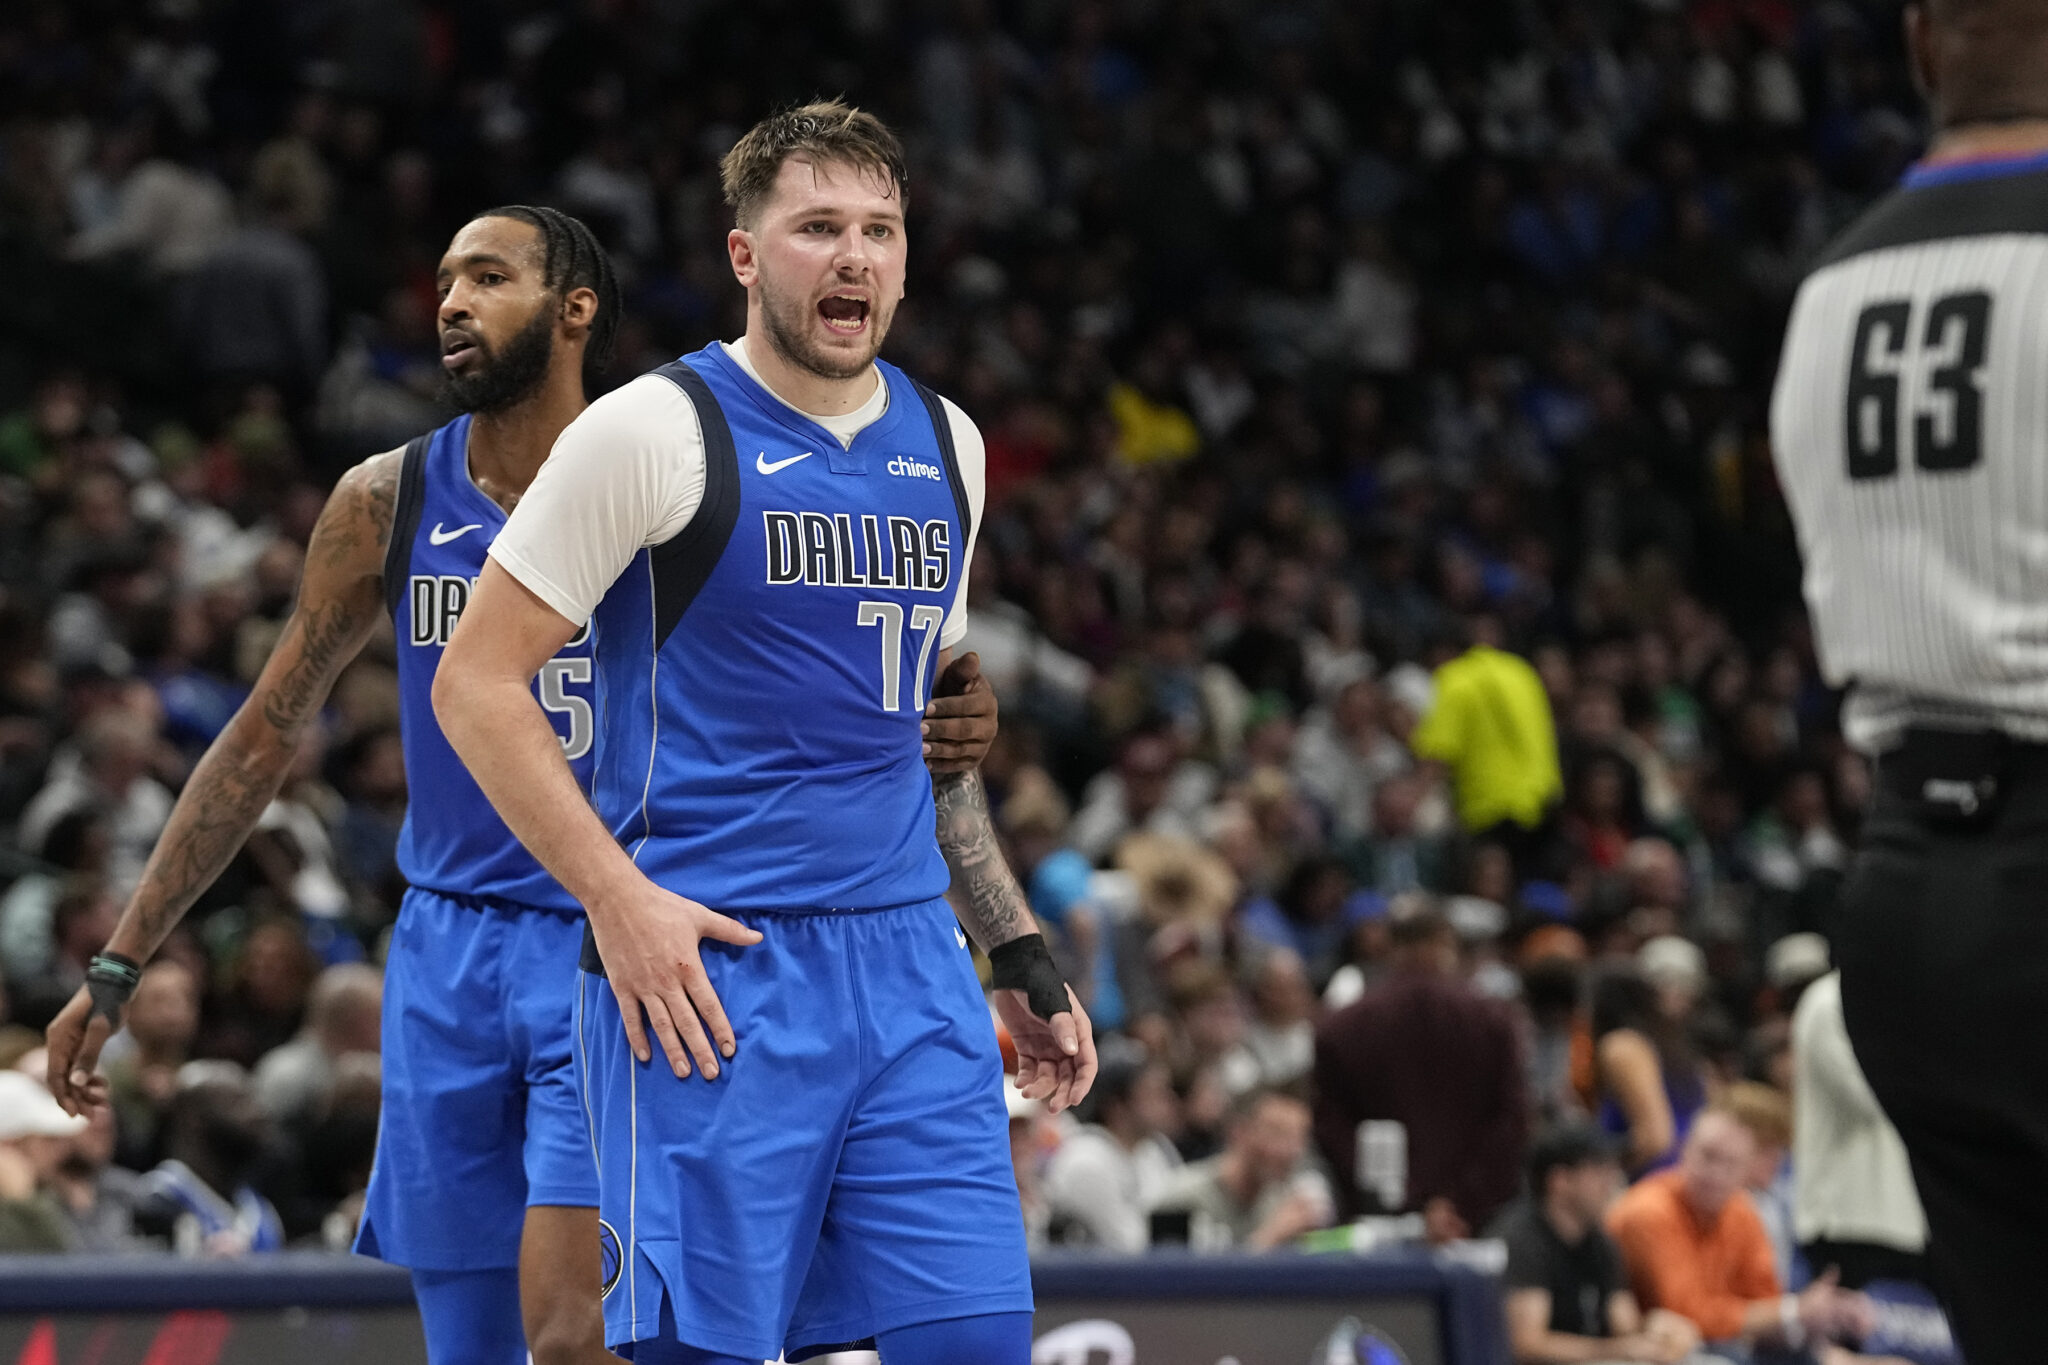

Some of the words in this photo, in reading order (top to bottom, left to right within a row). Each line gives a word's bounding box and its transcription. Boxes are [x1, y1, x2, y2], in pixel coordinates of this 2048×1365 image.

[1845, 289, 1994, 481] 63
[887, 455, 941, 481] chime
[762, 511, 950, 591] DALLAS
[857, 601, 944, 712] 77
